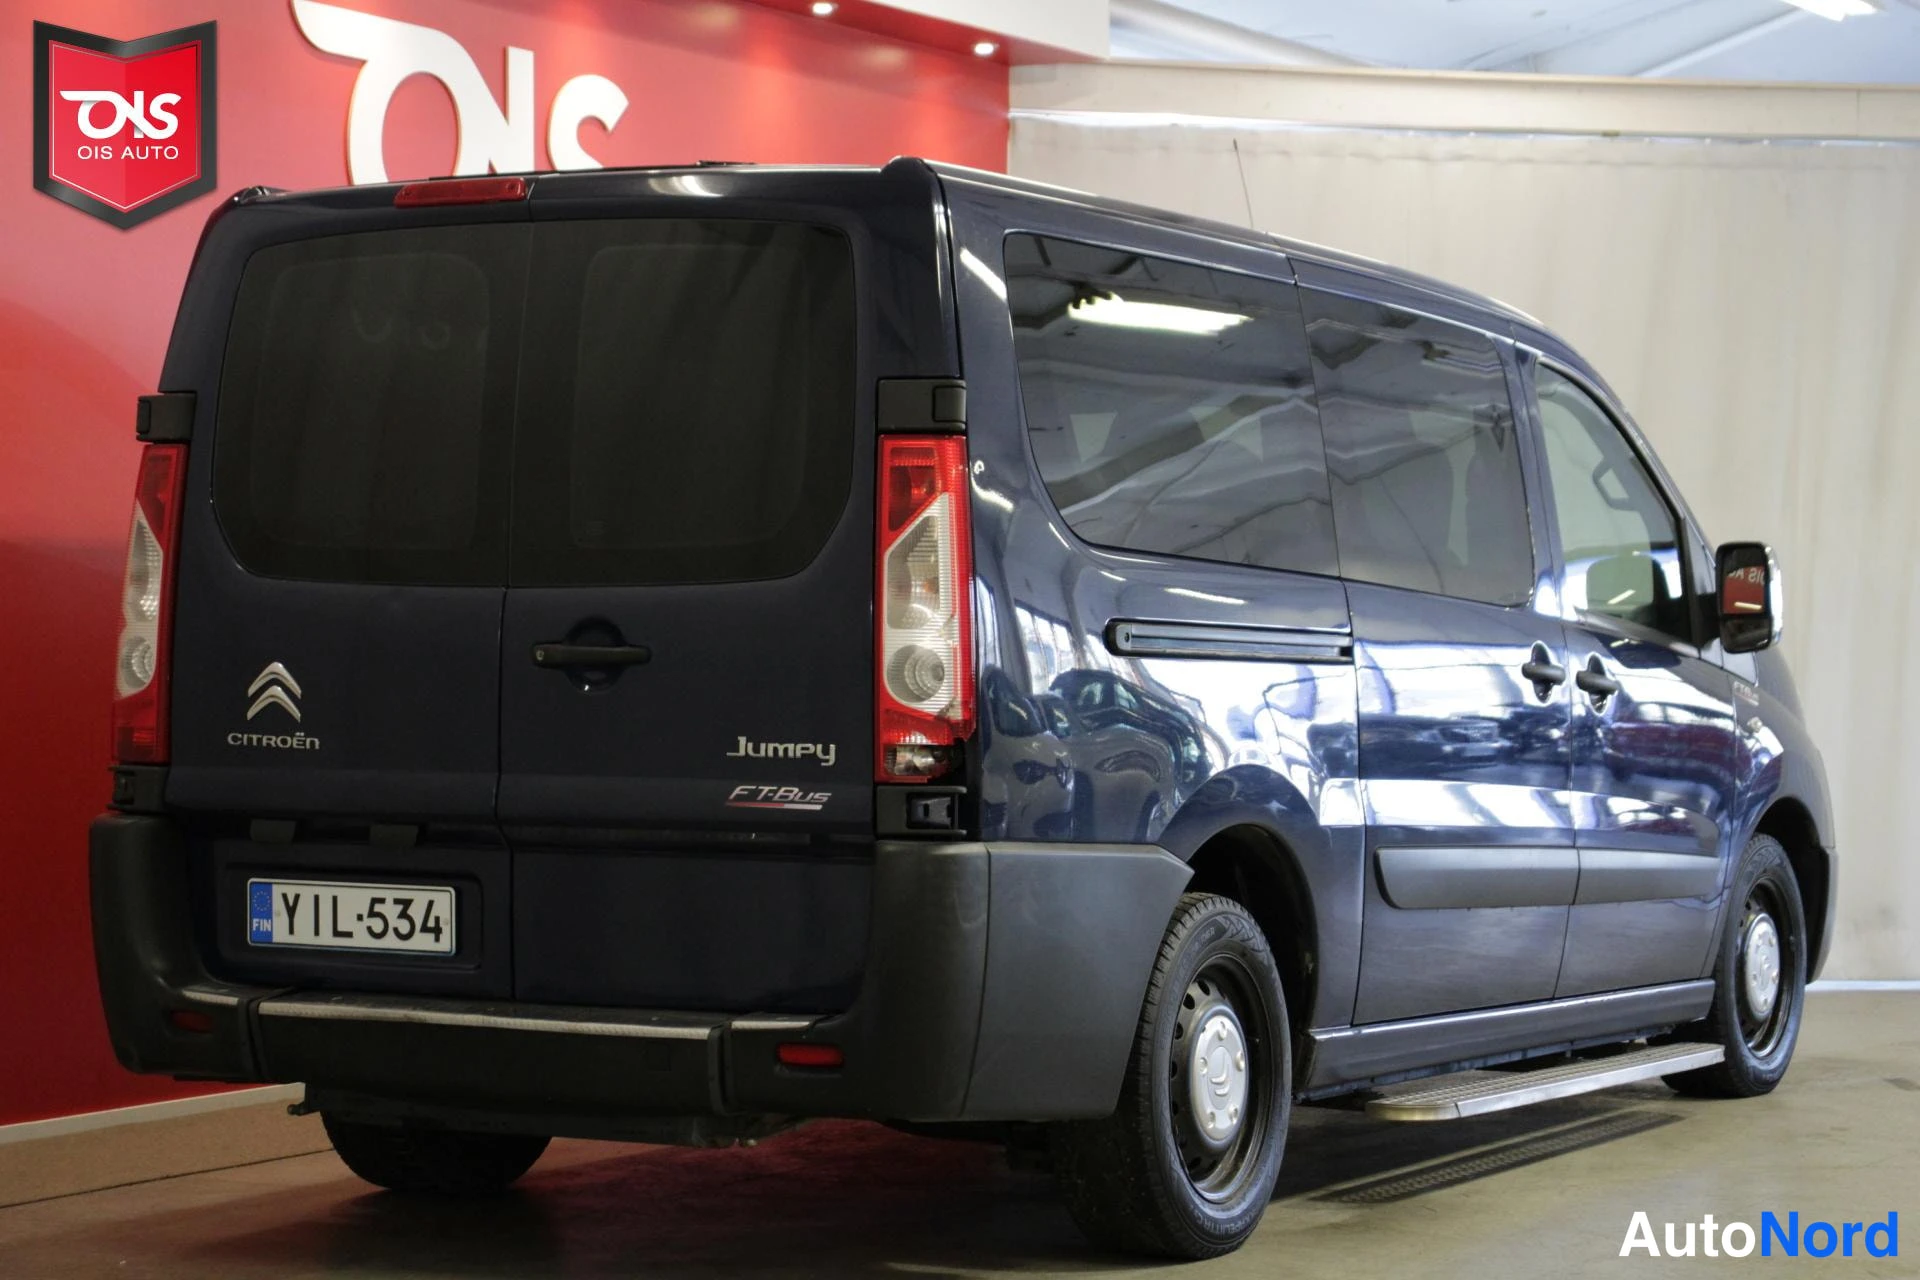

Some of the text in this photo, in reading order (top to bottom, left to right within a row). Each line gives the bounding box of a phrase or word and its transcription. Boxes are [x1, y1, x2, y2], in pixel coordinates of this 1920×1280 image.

[726, 735, 836, 767] Jumpy
[728, 785, 832, 803] FT-Bus
[252, 918, 272, 932] FIN
